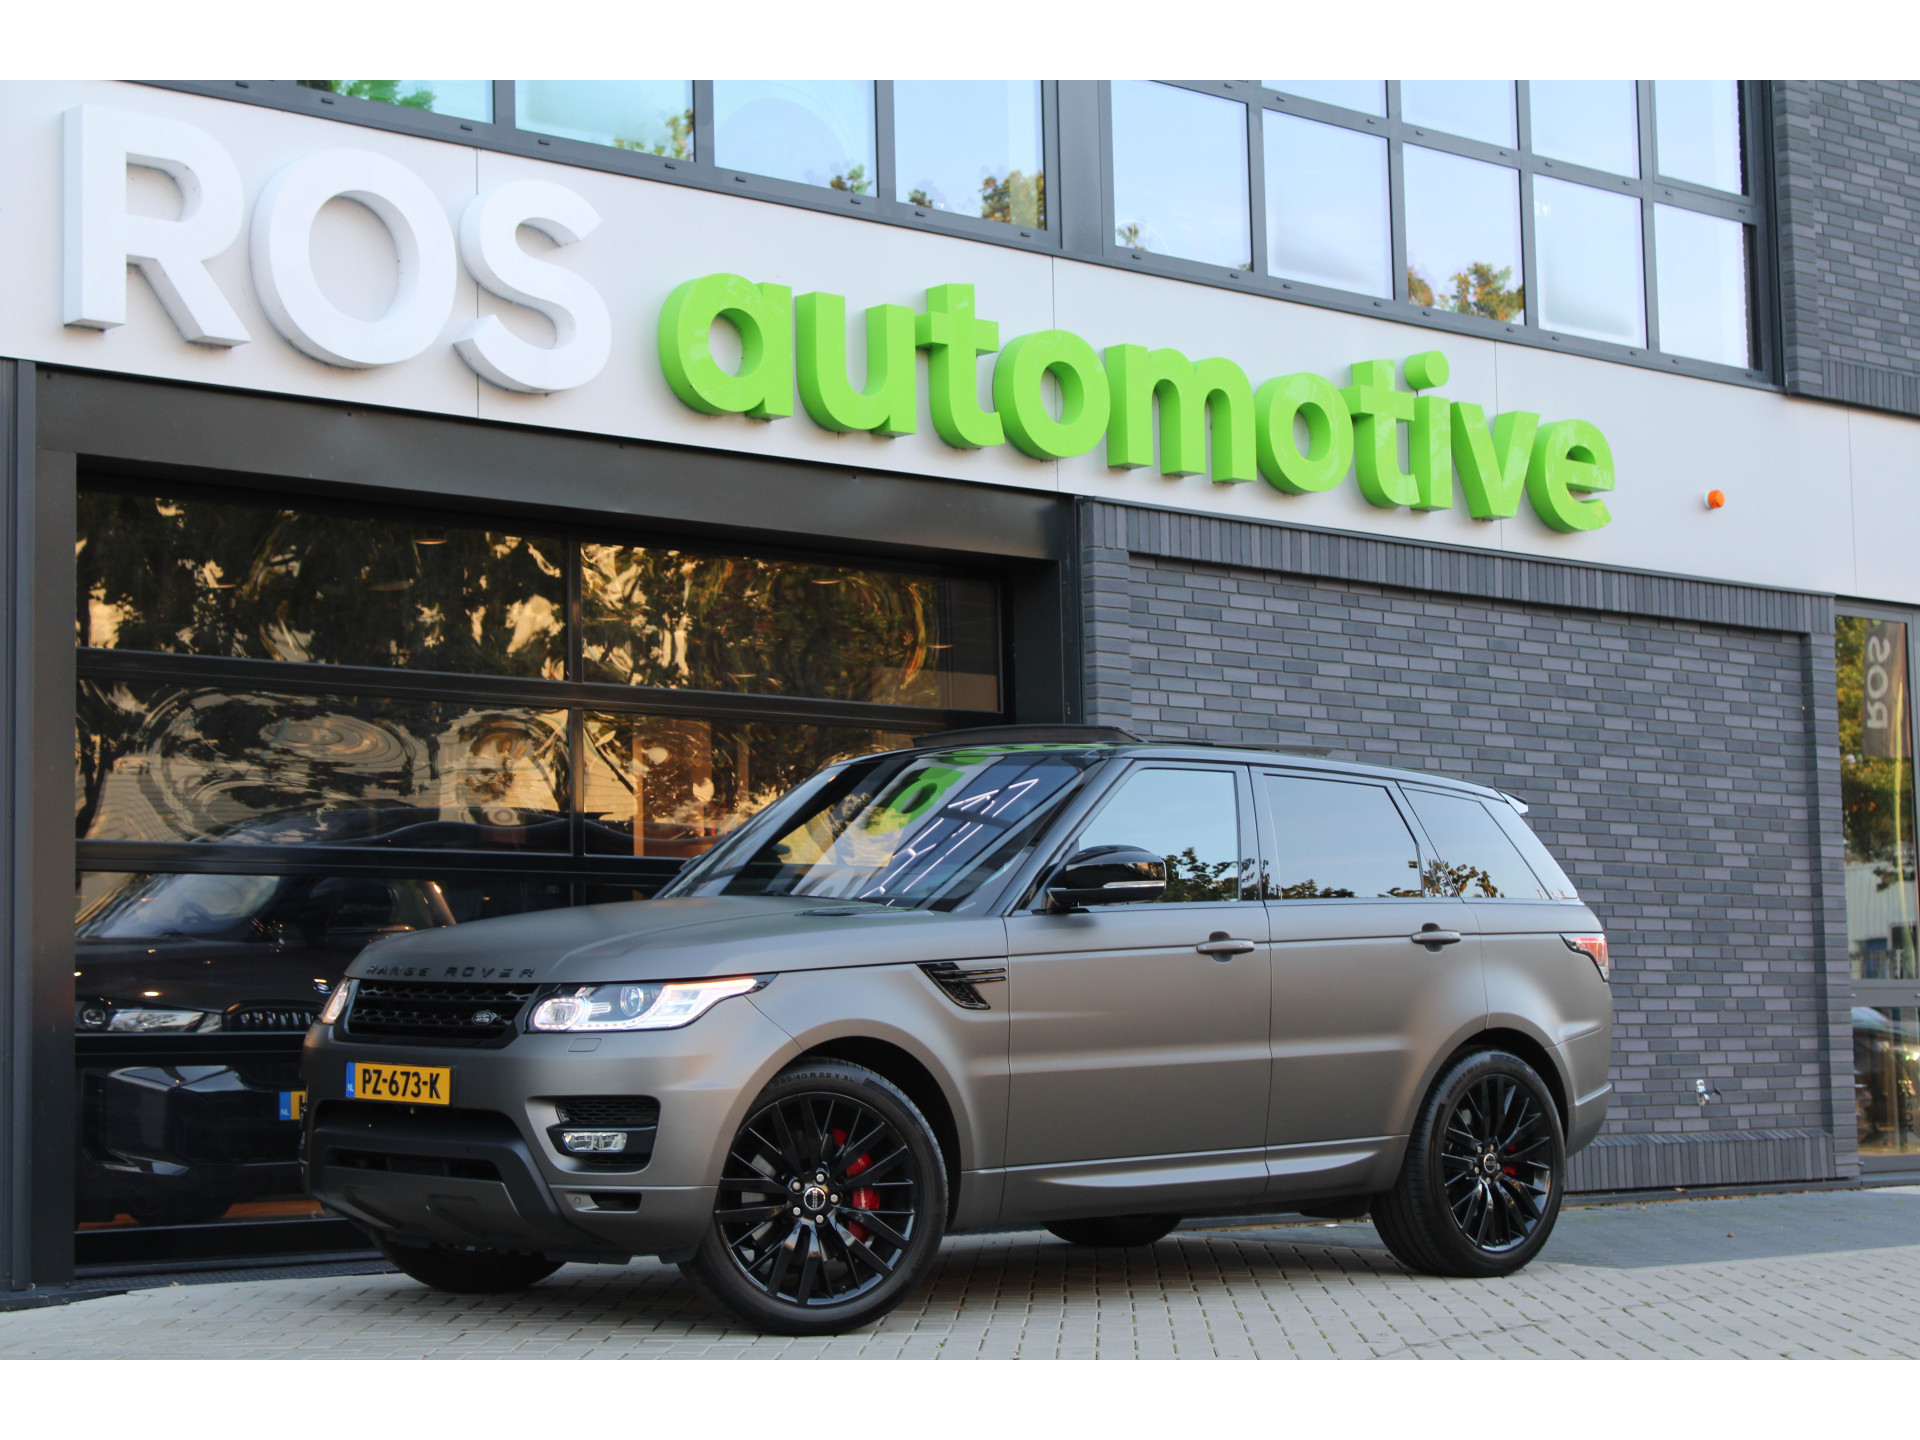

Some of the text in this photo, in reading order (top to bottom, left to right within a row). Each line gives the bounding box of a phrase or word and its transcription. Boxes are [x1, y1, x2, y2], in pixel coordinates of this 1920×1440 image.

[63, 104, 1615, 534] ROS automotive
[366, 965, 535, 979] RANGE ROVER
[347, 1083, 354, 1092] NL
[362, 1068, 441, 1099] PZ-673-K
[280, 1108, 289, 1116] NL
